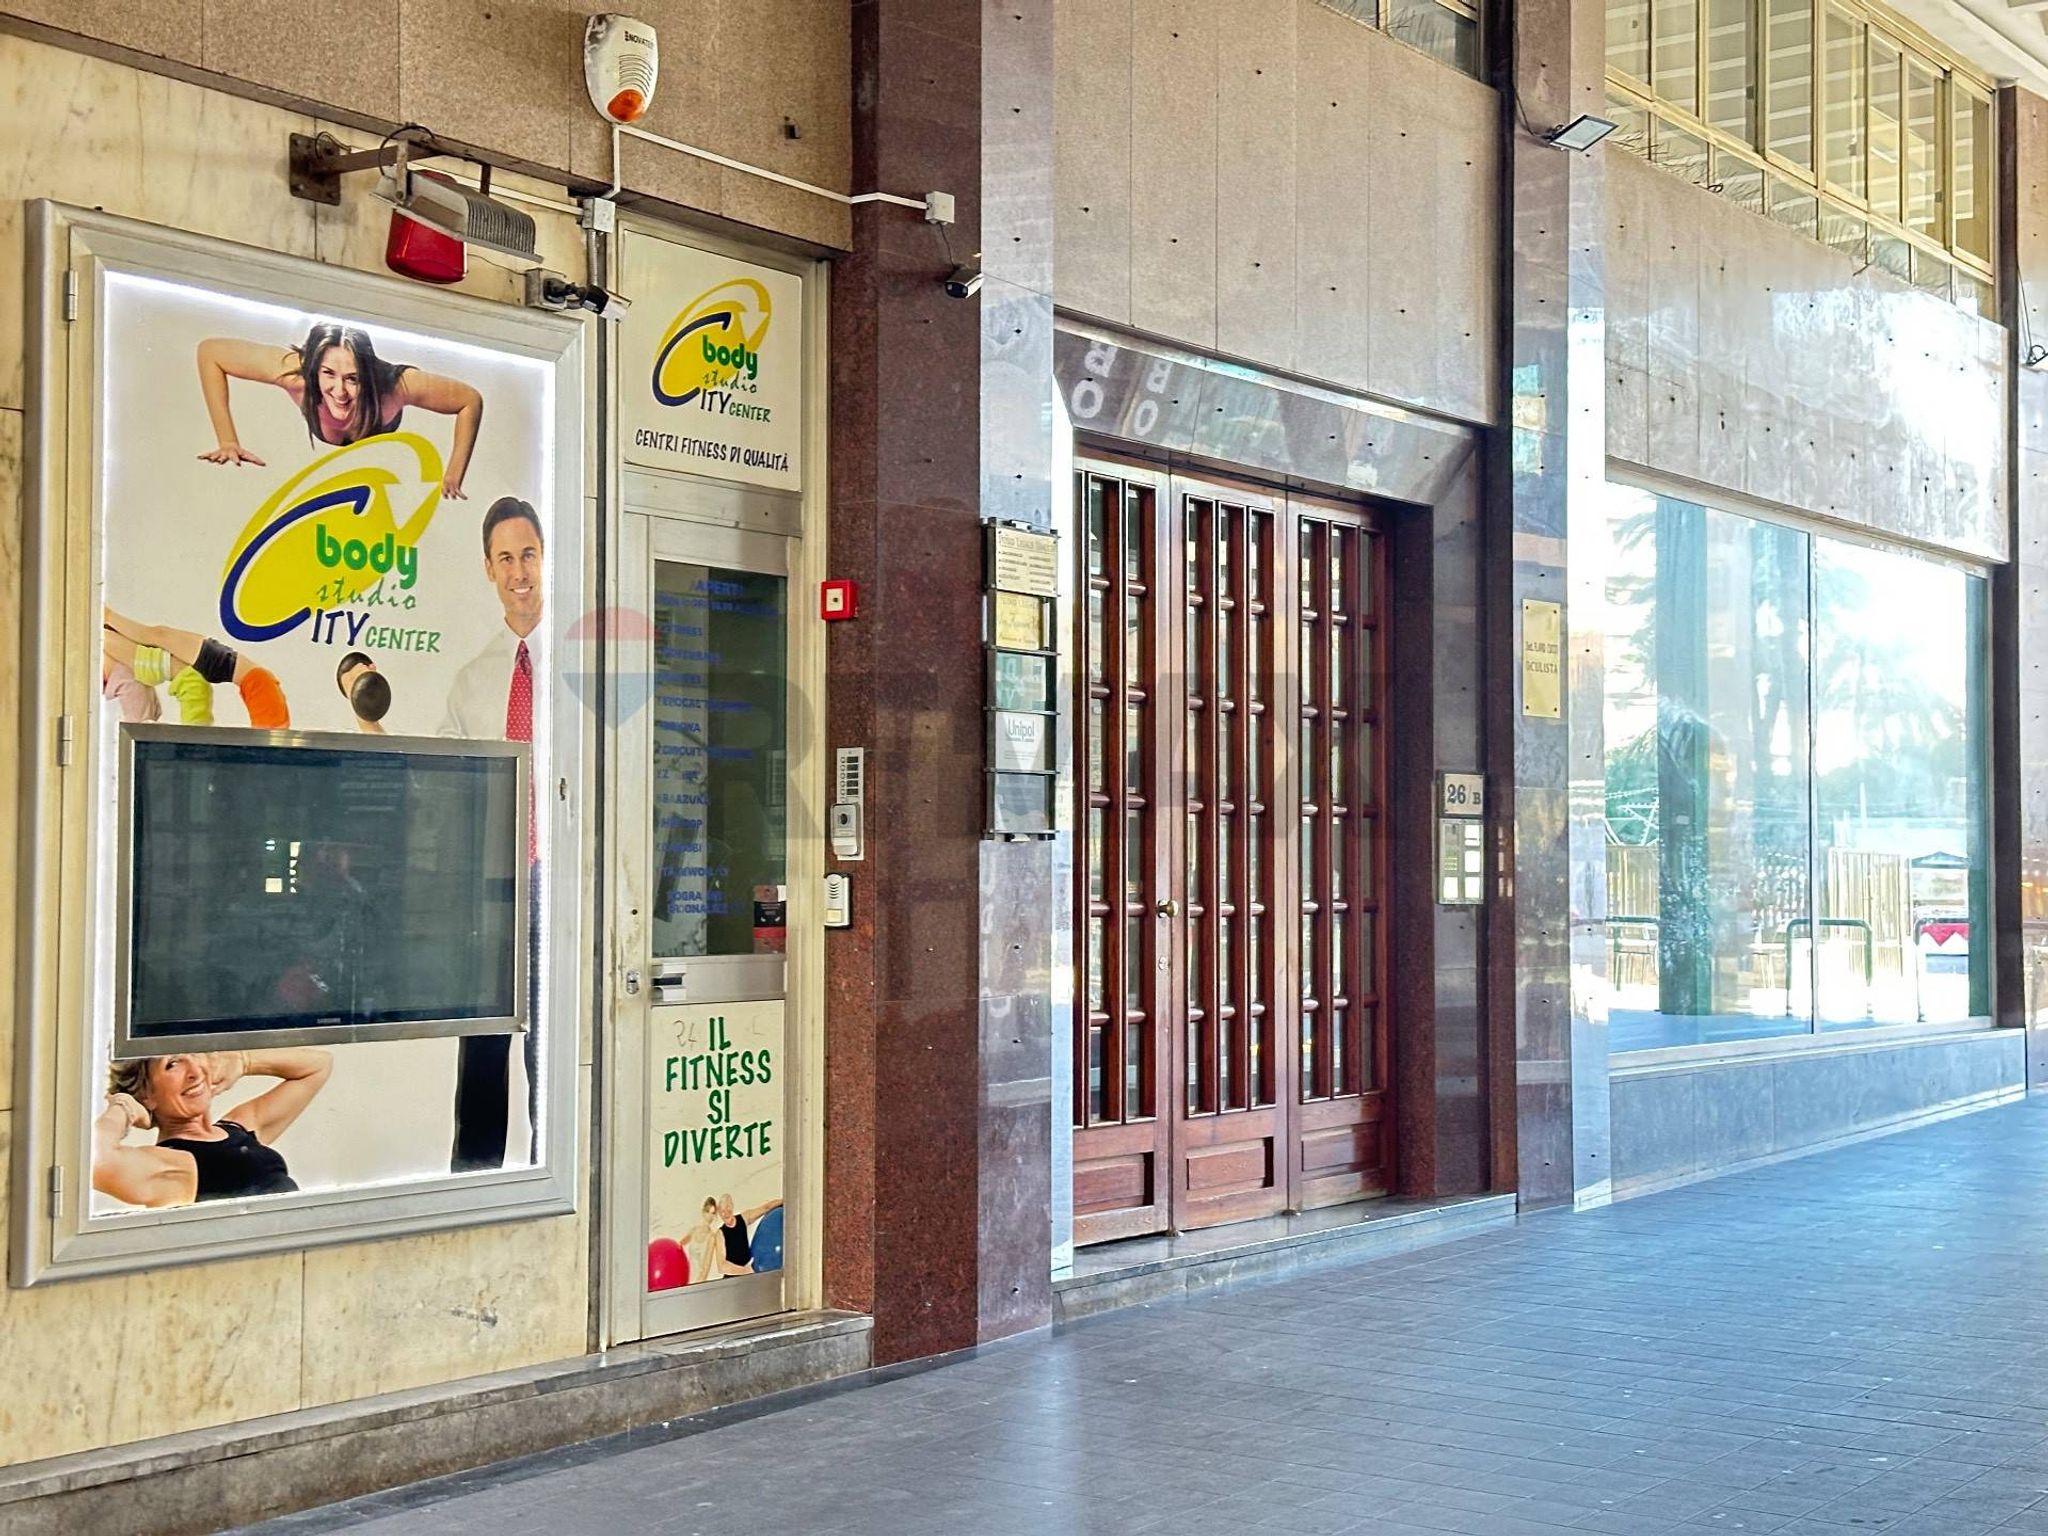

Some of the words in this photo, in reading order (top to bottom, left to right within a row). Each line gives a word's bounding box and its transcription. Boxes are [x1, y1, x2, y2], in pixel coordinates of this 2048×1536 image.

[702, 335, 758, 380] body
[702, 369, 758, 393] studio
[728, 402, 772, 423] CENTER
[635, 428, 679, 452] CENTRI
[681, 437, 728, 461] FITNESS
[729, 446, 742, 463] DI
[316, 523, 418, 589] body
[316, 577, 417, 610] studio
[365, 625, 442, 653] CENTER
[1007, 718, 1035, 740] Unipol
[709, 1016, 731, 1051] IL
[666, 1049, 772, 1092] FITNESS
[707, 1089, 730, 1125] SI
[664, 1120, 772, 1168] DIVERTE
